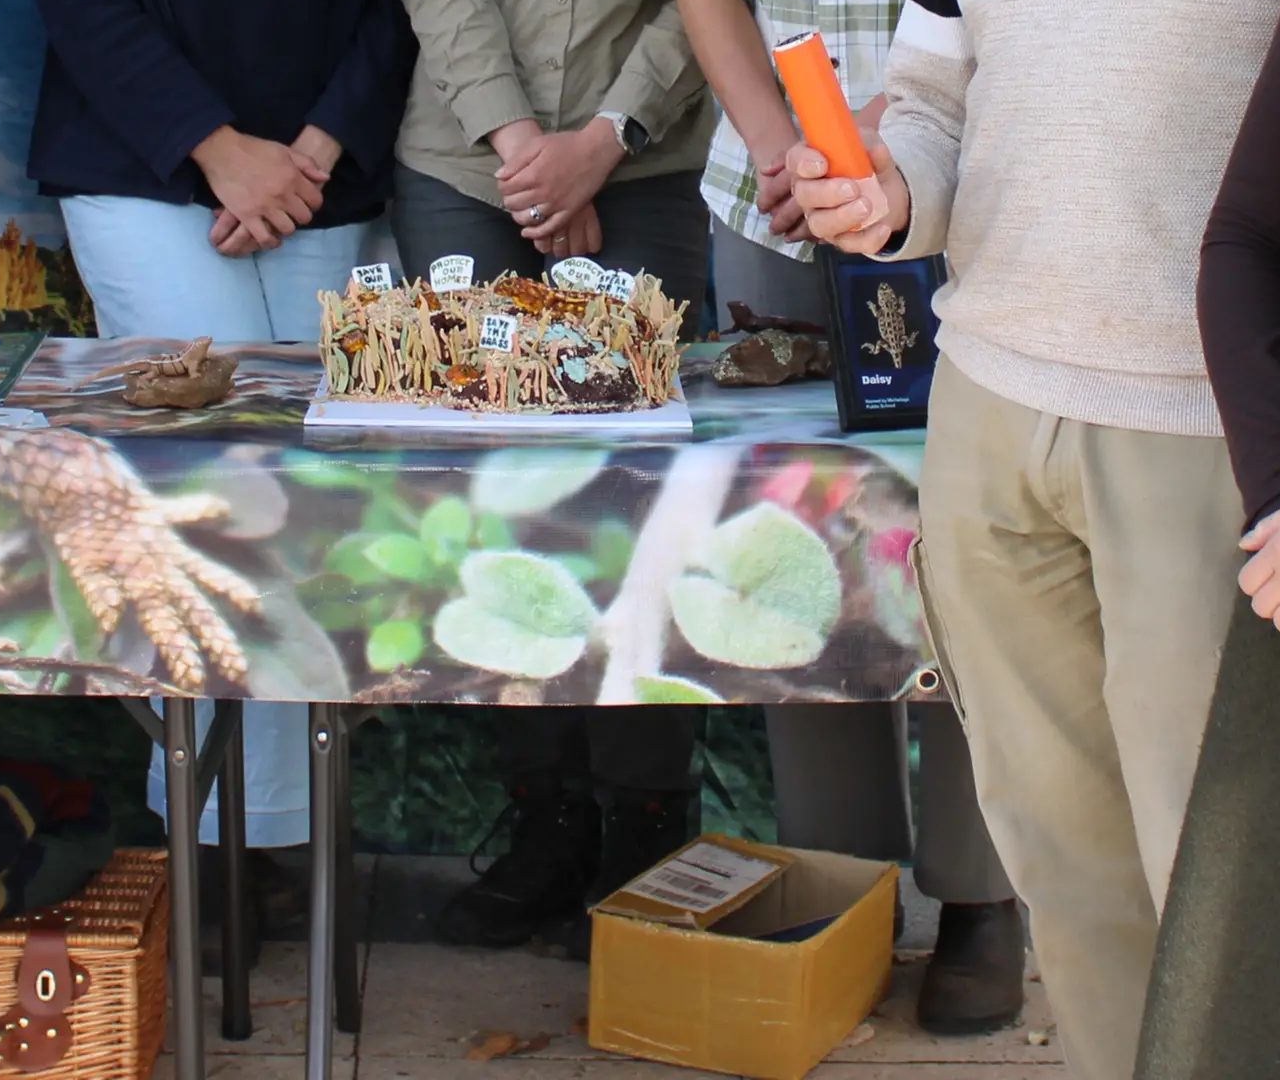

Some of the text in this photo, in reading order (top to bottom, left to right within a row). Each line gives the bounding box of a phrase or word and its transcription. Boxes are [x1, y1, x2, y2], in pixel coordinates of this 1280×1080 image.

[356, 265, 383, 277] SAVE
[431, 257, 471, 273] PROTECT
[443, 266, 464, 275] OUR
[564, 259, 603, 277] PROTECT
[364, 274, 384, 284] OUR
[434, 274, 471, 287] HOMES
[568, 268, 591, 281] OUR
[486, 317, 510, 329] SAVE
[487, 328, 507, 339] THE
[862, 374, 892, 385] Daisy
